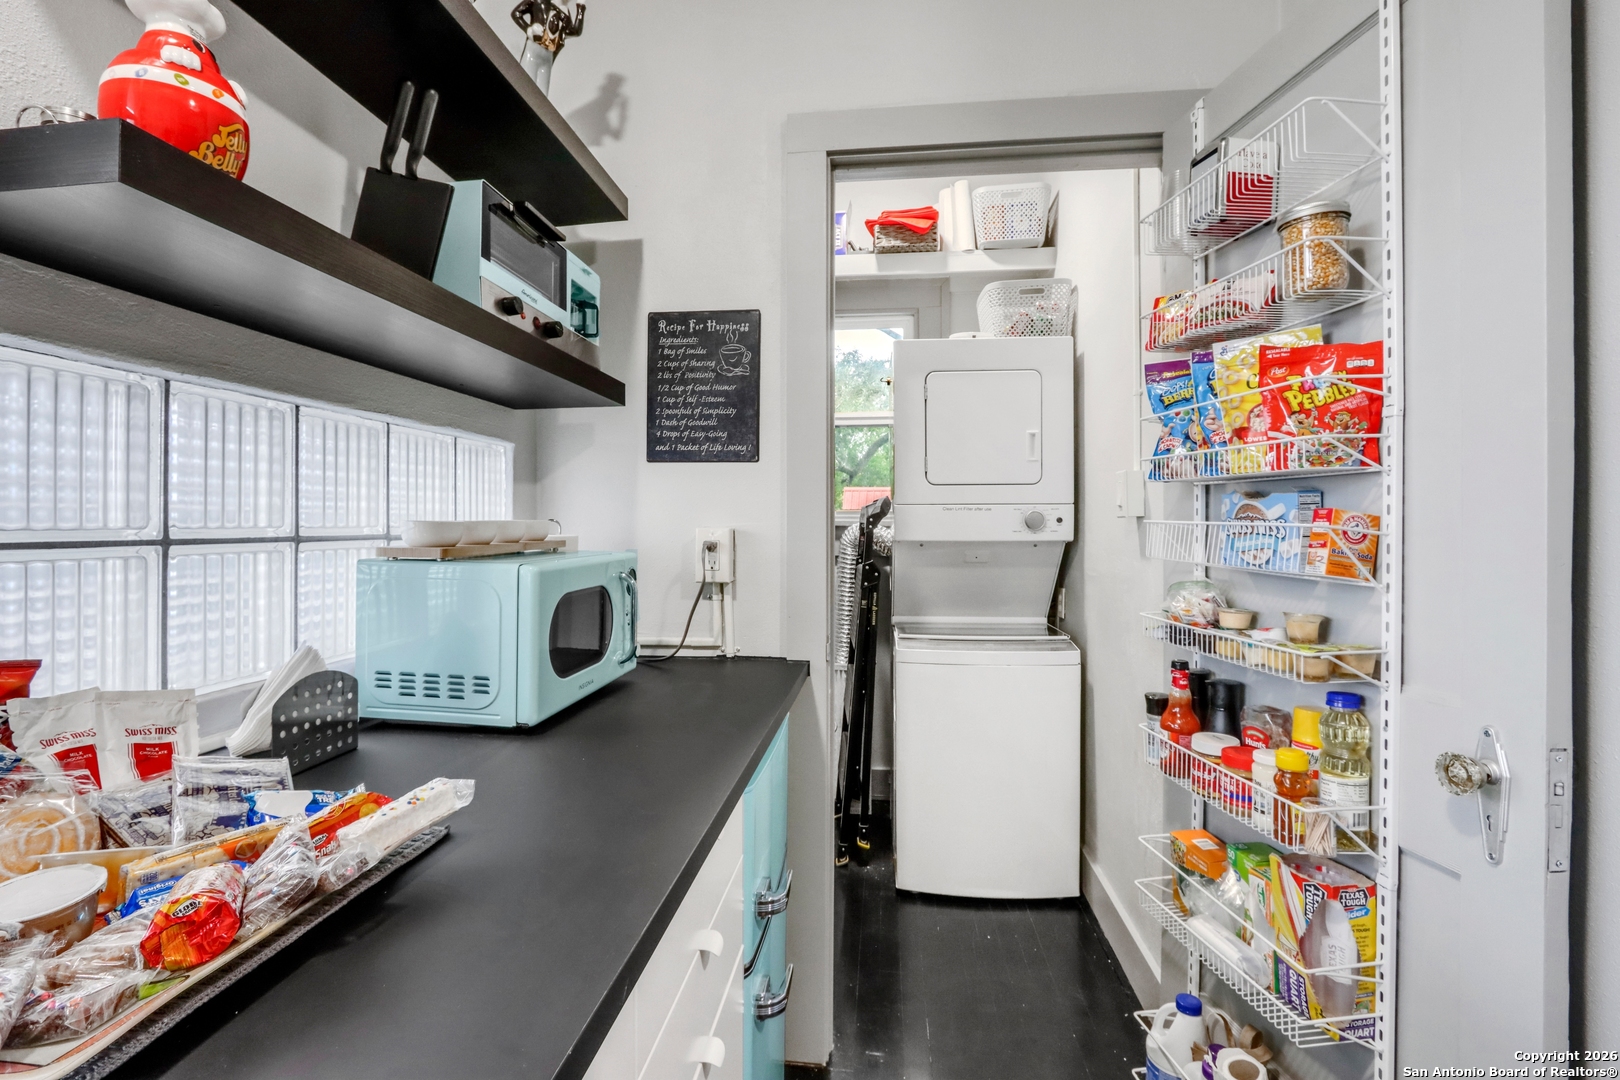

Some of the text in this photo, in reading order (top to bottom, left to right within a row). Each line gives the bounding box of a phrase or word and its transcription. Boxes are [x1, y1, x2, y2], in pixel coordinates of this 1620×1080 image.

[212, 123, 248, 161] Jelly
[188, 141, 241, 179] Belly
[657, 318, 750, 335] Recipe For Happiness
[658, 335, 699, 347] Ingredients:
[663, 348, 675, 358] Bag
[677, 346, 686, 359] of
[685, 345, 708, 355] Smiles
[656, 358, 716, 372] 2 Cups of Sharing
[1269, 366, 1287, 376] Post
[663, 371, 672, 379] lbs
[673, 372, 683, 384] of
[684, 371, 717, 381] Positivity
[658, 381, 737, 395] 1/2 Cup of Good Humor
[662, 396, 676, 406] Cup
[676, 394, 686, 407] of
[685, 394, 698, 407] Self
[661, 407, 692, 418] Spoonfuls
[693, 406, 702, 419] of
[701, 406, 737, 418] Simplicity
[661, 418, 679, 426] Dash
[678, 418, 688, 431] of
[687, 417, 718, 426] Goodwill
[662, 430, 680, 440] Drops
[681, 429, 690, 442] of
[690, 429, 728, 441] Easy-Going
[655, 443, 671, 451] and
[676, 443, 700, 451] Packet
[700, 442, 709, 455] of
[708, 442, 723, 454] Life
[723, 443, 747, 455] Loving
[1357, 552, 1372, 560] Soda
[124, 726, 178, 738] SWISS MISS
[39, 736, 70, 750] SWISS
[70, 728, 97, 740] MISS
[140, 879, 177, 894] Original
[1341, 891, 1365, 900] TEXAS
[1305, 885, 1316, 922] TOUGH
[1340, 898, 1366, 907] TOUGH
[1289, 969, 1302, 1013] QUART
